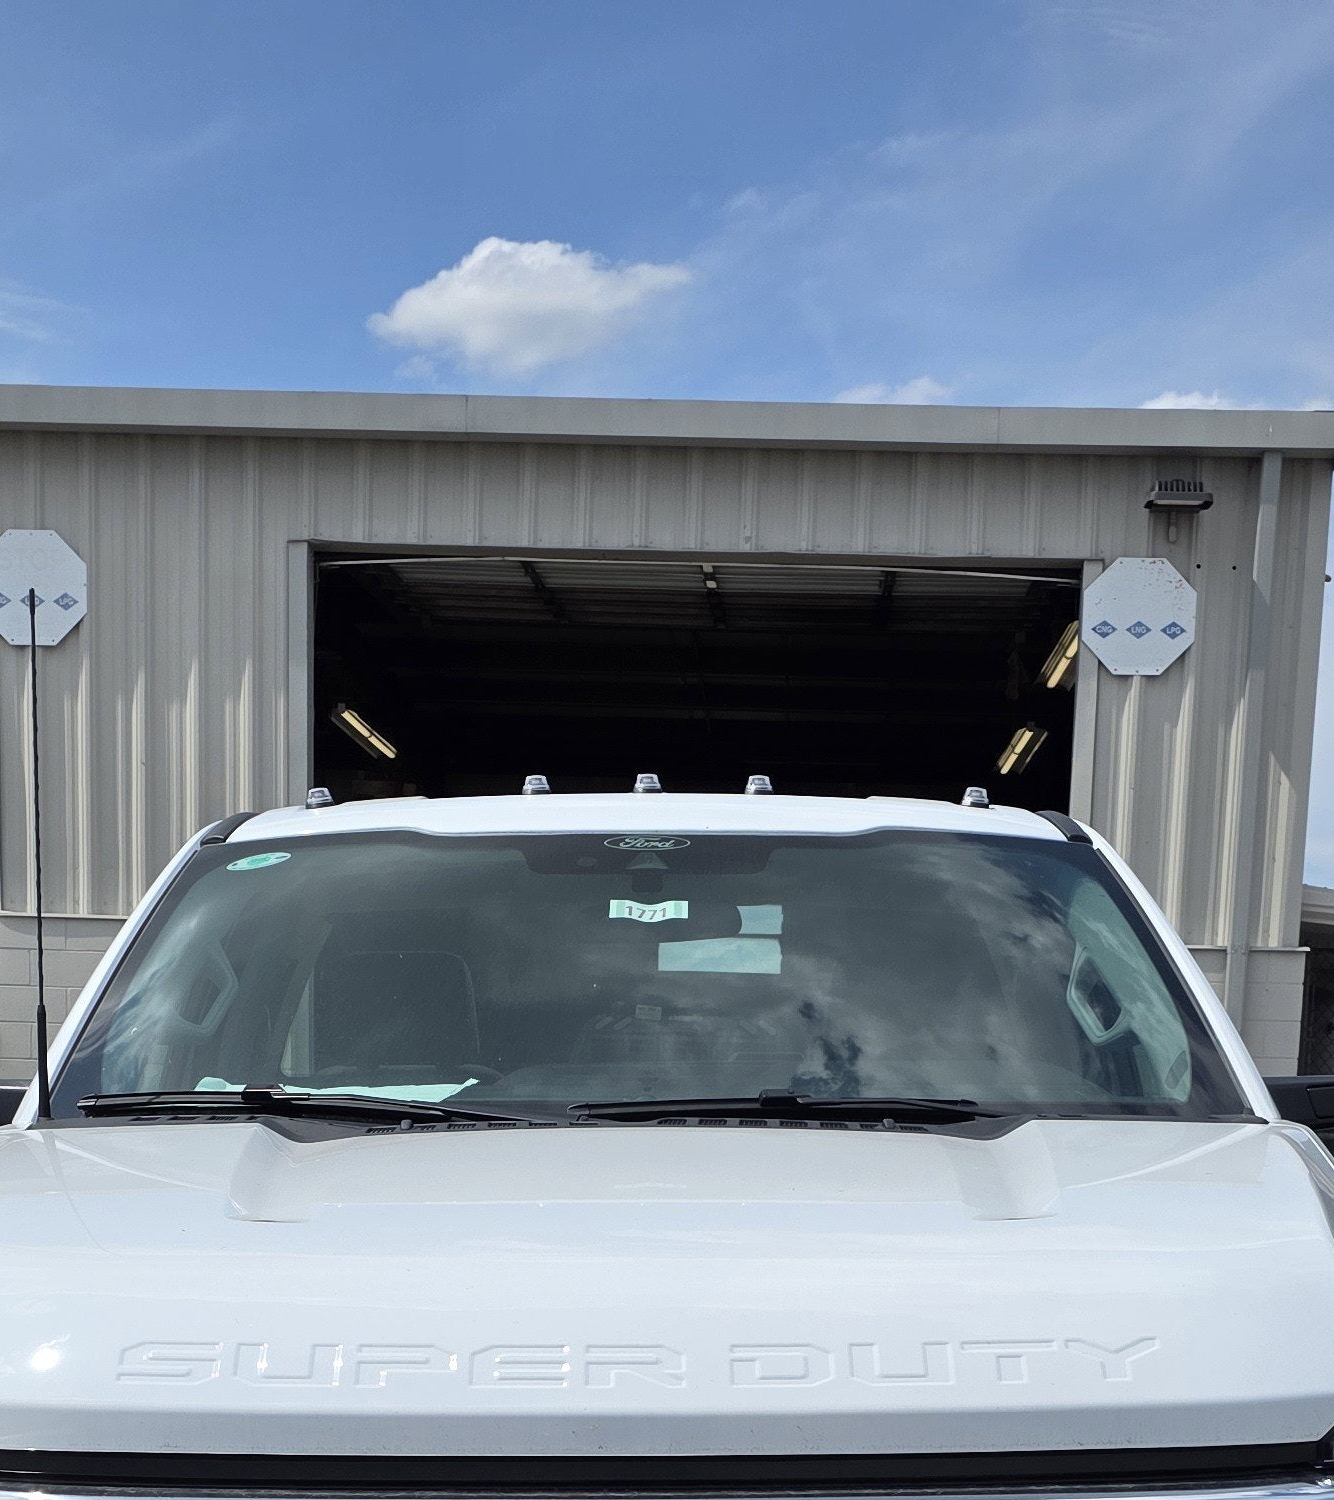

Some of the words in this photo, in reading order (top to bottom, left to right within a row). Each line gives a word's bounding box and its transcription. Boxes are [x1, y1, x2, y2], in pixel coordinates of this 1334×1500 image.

[1095, 625, 1113, 633] CNG
[1131, 626, 1147, 634] LNG
[1166, 626, 1181, 634] LPG
[619, 836, 676, 849] Ford
[625, 905, 667, 920] 1771
[115, 1340, 688, 1389] SUPER
[729, 1337, 1160, 1388] DUTY
